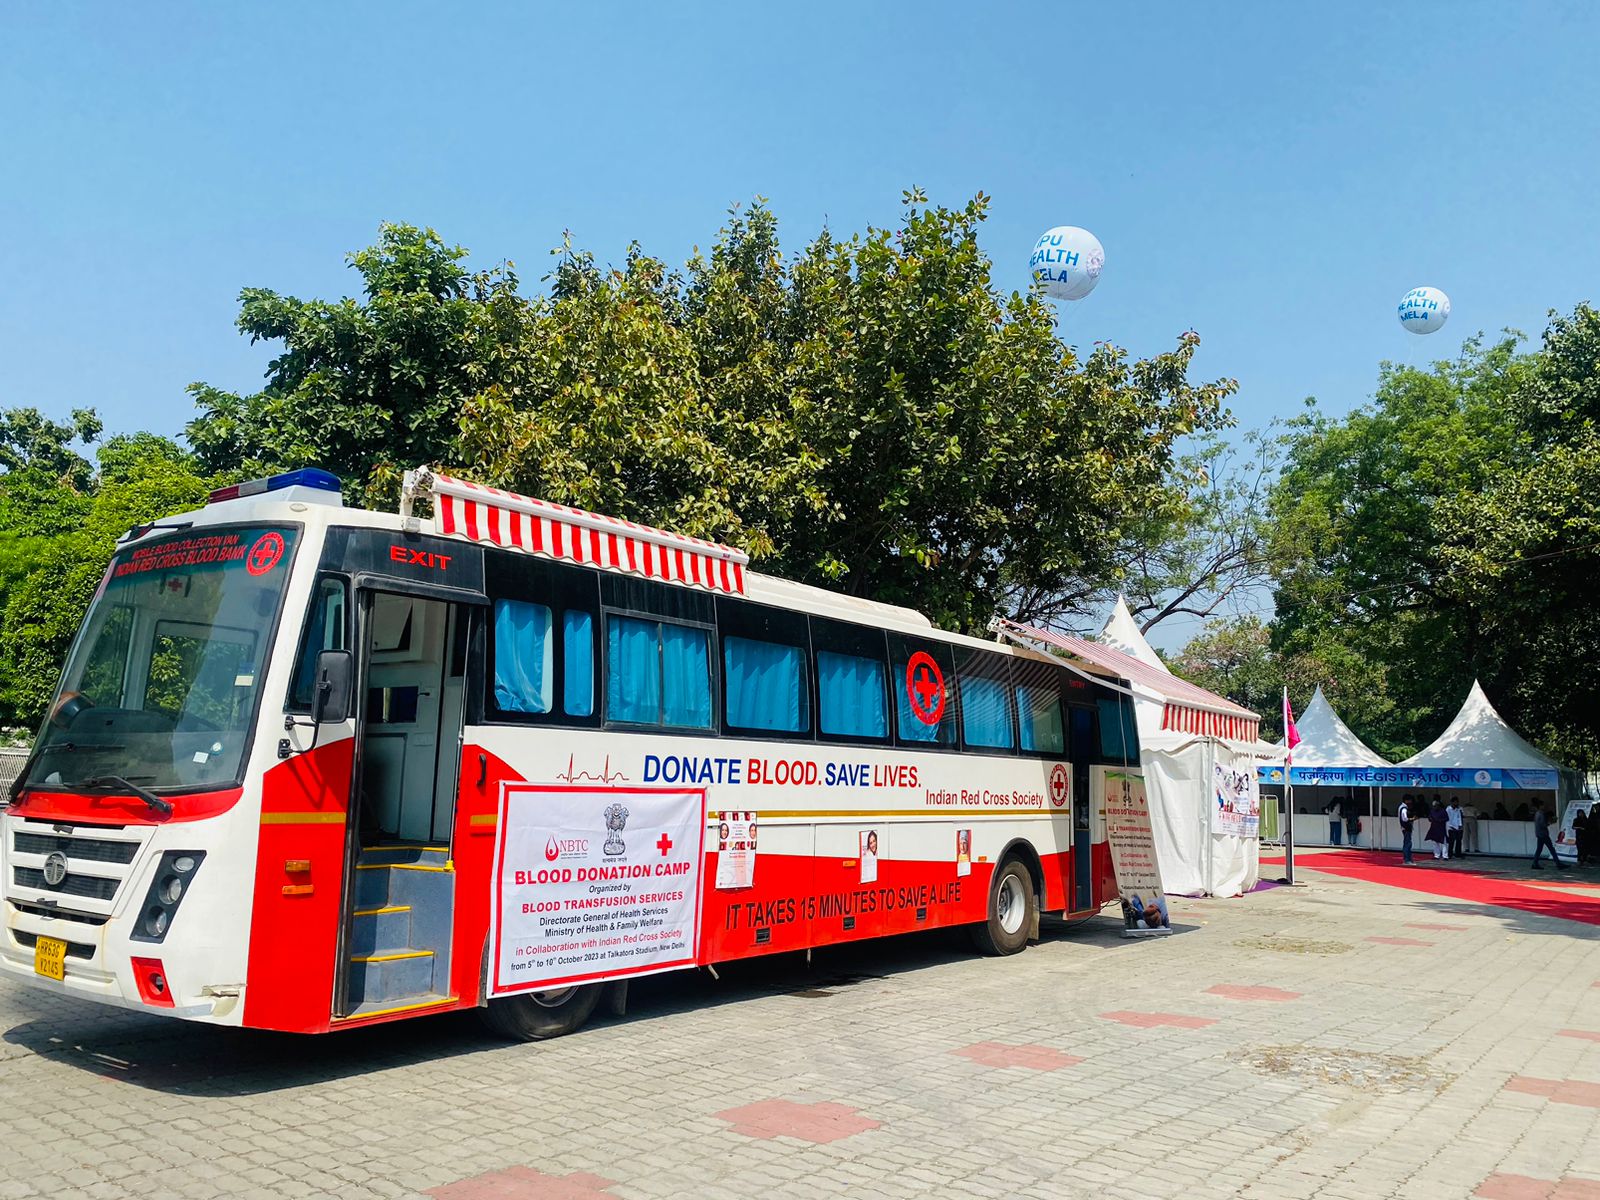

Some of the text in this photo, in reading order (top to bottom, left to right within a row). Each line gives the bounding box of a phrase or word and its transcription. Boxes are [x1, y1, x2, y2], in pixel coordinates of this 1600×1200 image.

[154, 541, 178, 555] BLOOD
[178, 537, 223, 551] COLLECTION
[222, 534, 240, 545] VAN
[140, 555, 157, 572] RED
[156, 550, 186, 569] CROSS
[184, 547, 220, 564] BLOOD
[218, 544, 248, 560] BANK
[390, 545, 452, 570] EXIT
[643, 755, 921, 788] DONATE BLOOD. SAVE LIVES.
[1355, 772, 1460, 783] REGISTRATION
[926, 789, 1044, 808] Indian Red Cross Society
[560, 840, 588, 852] NBTC
[515, 862, 690, 885] BLOOD DONATION CAMP
[589, 883, 632, 894] Organized by
[522, 891, 683, 913] BLOOD TRANSFUSION SERVICES
[726, 882, 961, 930] IT TAKES 15 MINUTES TO SAVE A LIFE
[540, 907, 669, 926] Directorate General of Health Services
[545, 918, 663, 938] Ministry of Health & Family Welfare
[516, 929, 683, 956] in Collaboration with Indian Red Cross Society
[511, 962, 526, 971] from
[537, 960, 544, 968] to
[558, 956, 583, 965] October
[584, 952, 599, 961] 2023
[607, 949, 635, 959] Talkatora
[671, 942, 685, 950] Delhi
